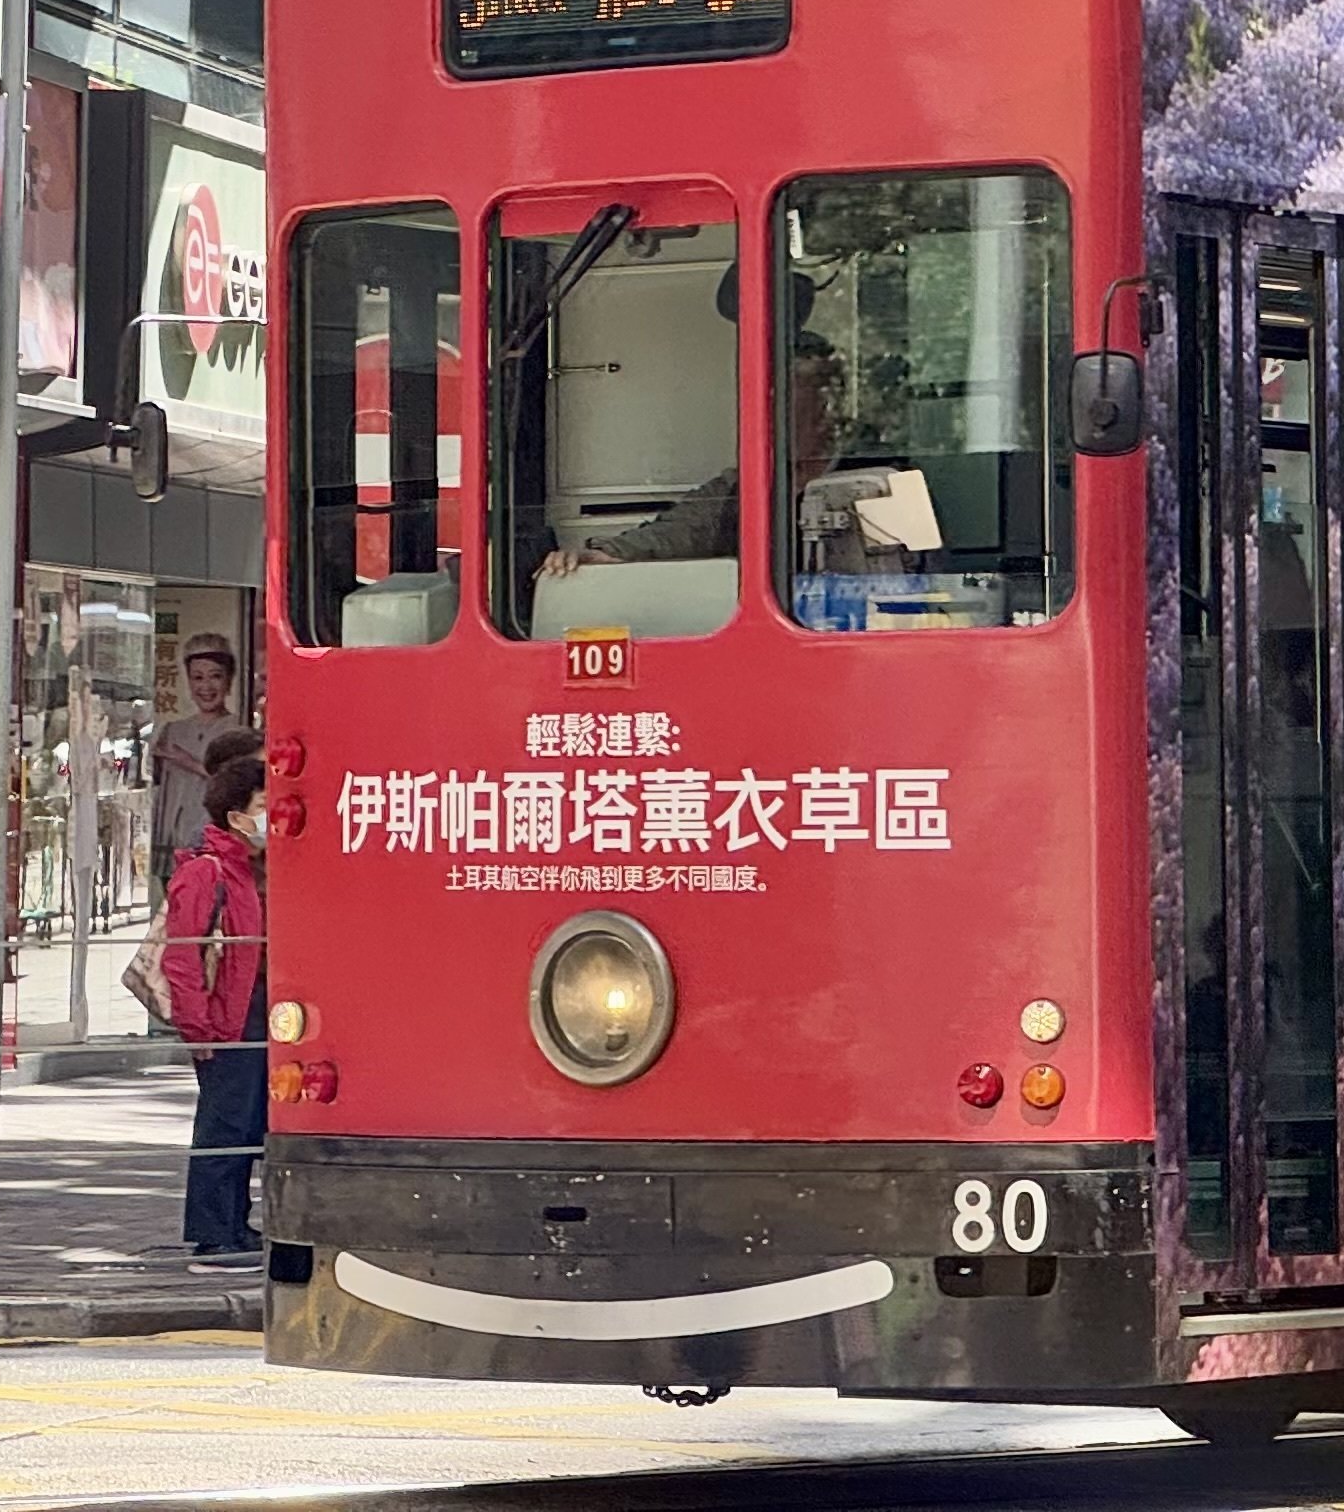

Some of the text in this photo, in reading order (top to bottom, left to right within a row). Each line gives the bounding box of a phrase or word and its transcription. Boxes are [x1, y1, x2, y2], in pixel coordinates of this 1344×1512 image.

[567, 644, 625, 676] 109
[526, 713, 682, 757] 輕鬆連繫:
[337, 768, 952, 853] 伊斯帕爾塔薰衣草區
[445, 865, 768, 892] 土耳其航空伴你飛到更多不同國度。
[950, 1179, 1048, 1254] 80
